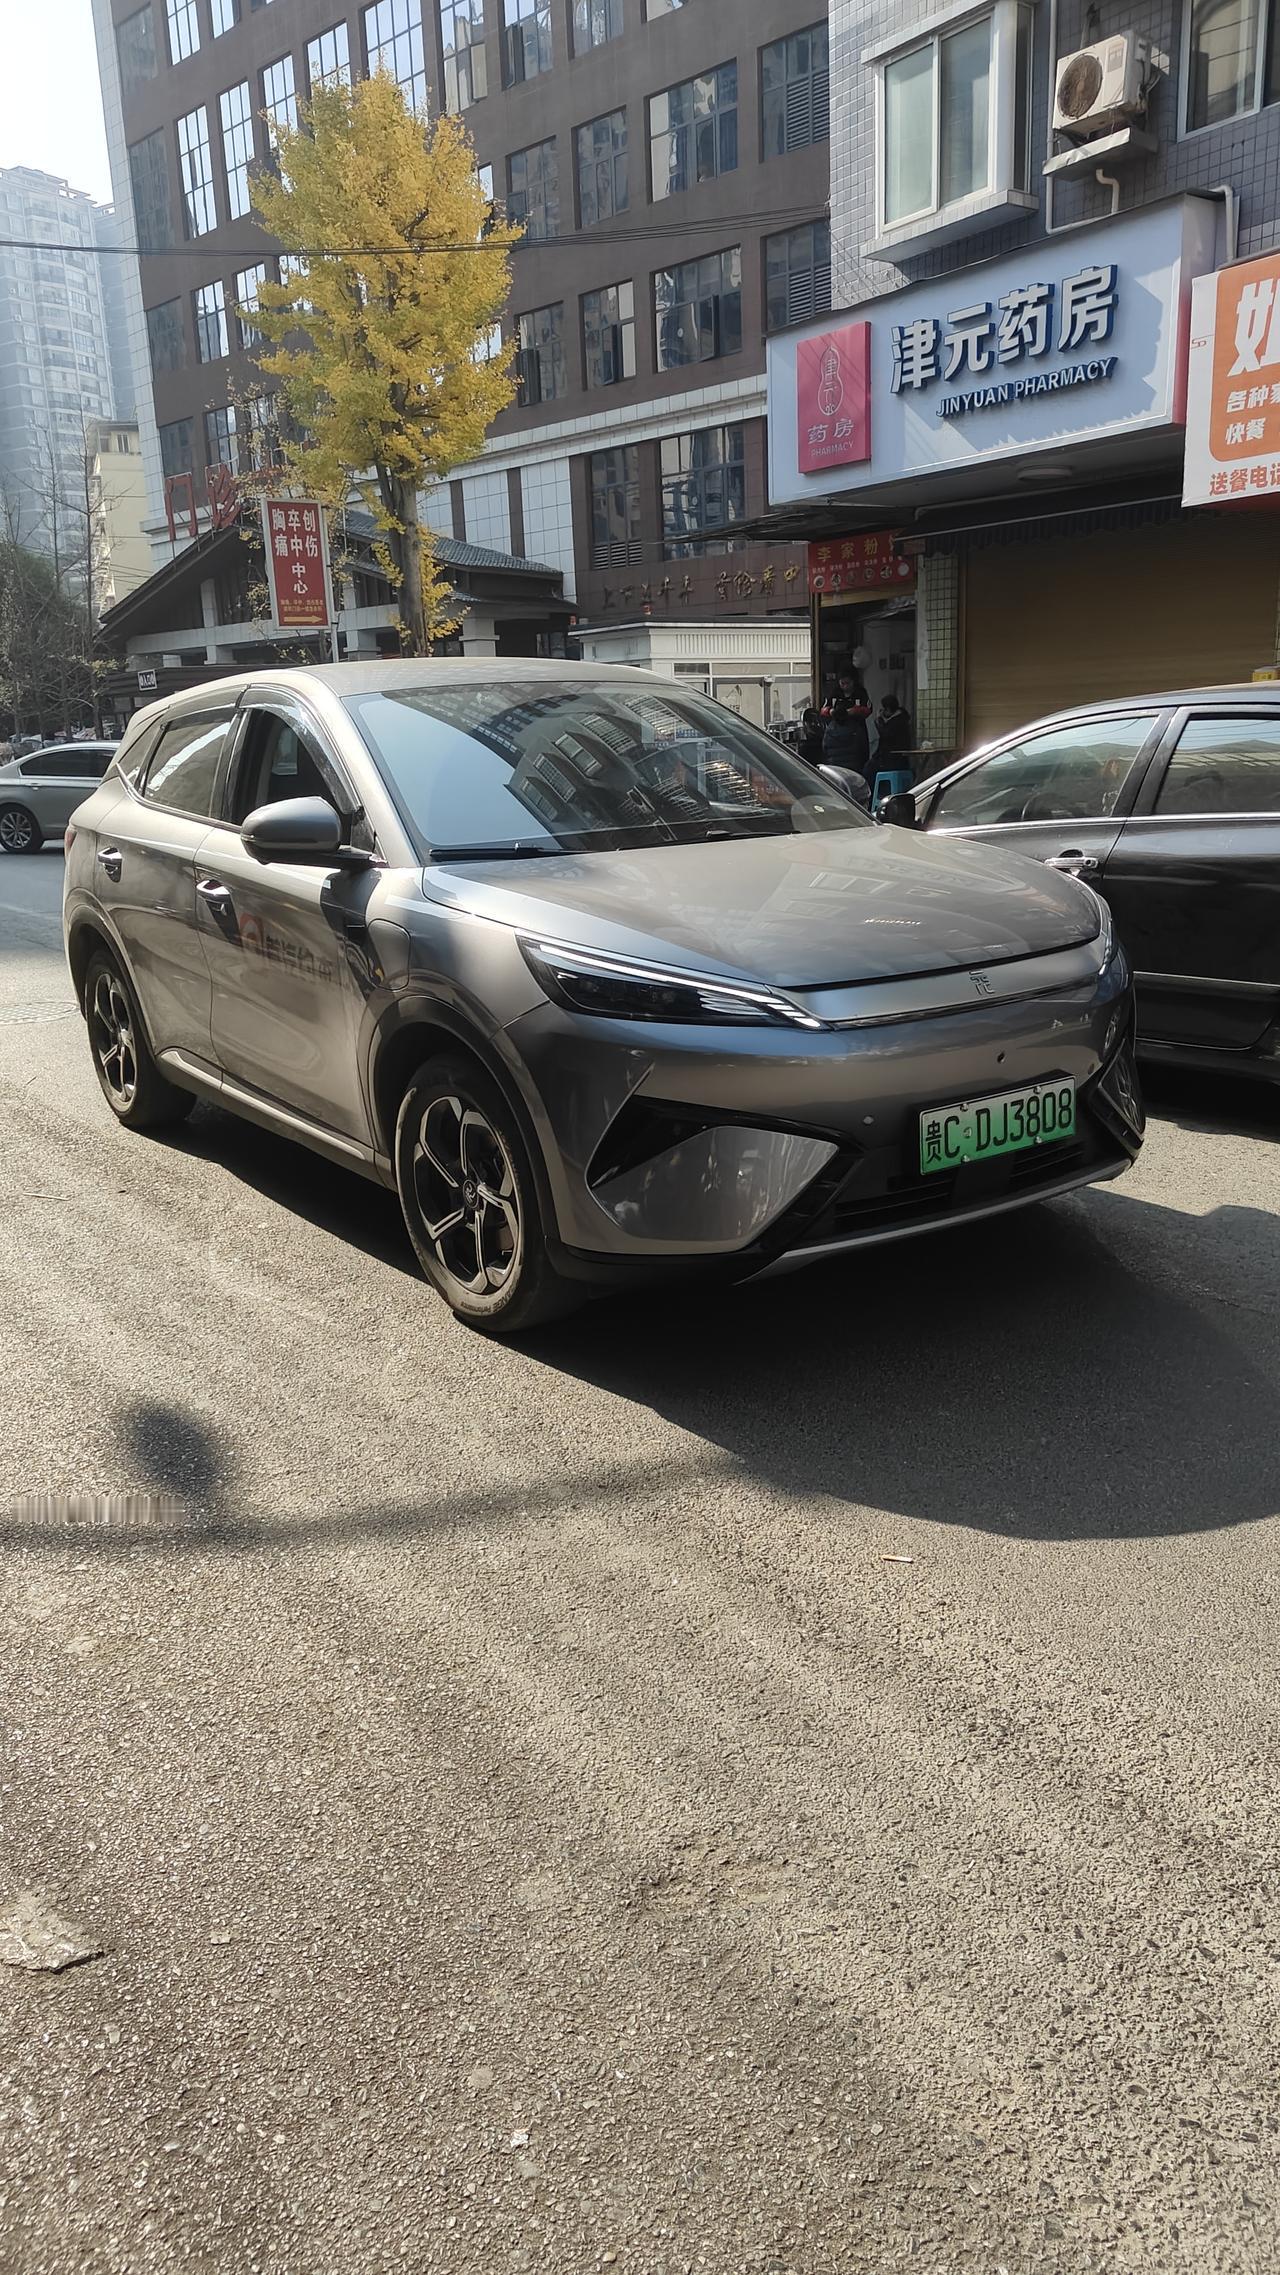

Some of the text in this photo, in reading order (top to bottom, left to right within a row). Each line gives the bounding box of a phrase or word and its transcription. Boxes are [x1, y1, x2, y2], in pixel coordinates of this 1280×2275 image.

[890, 264, 1118, 394] 津元药房
[936, 357, 1117, 417] JINYUAN PHARMACY
[808, 418, 854, 445] 药房
[1225, 418, 1266, 445] 快餐
[811, 441, 854, 457] PHARMACY
[291, 562, 309, 594] 中心
